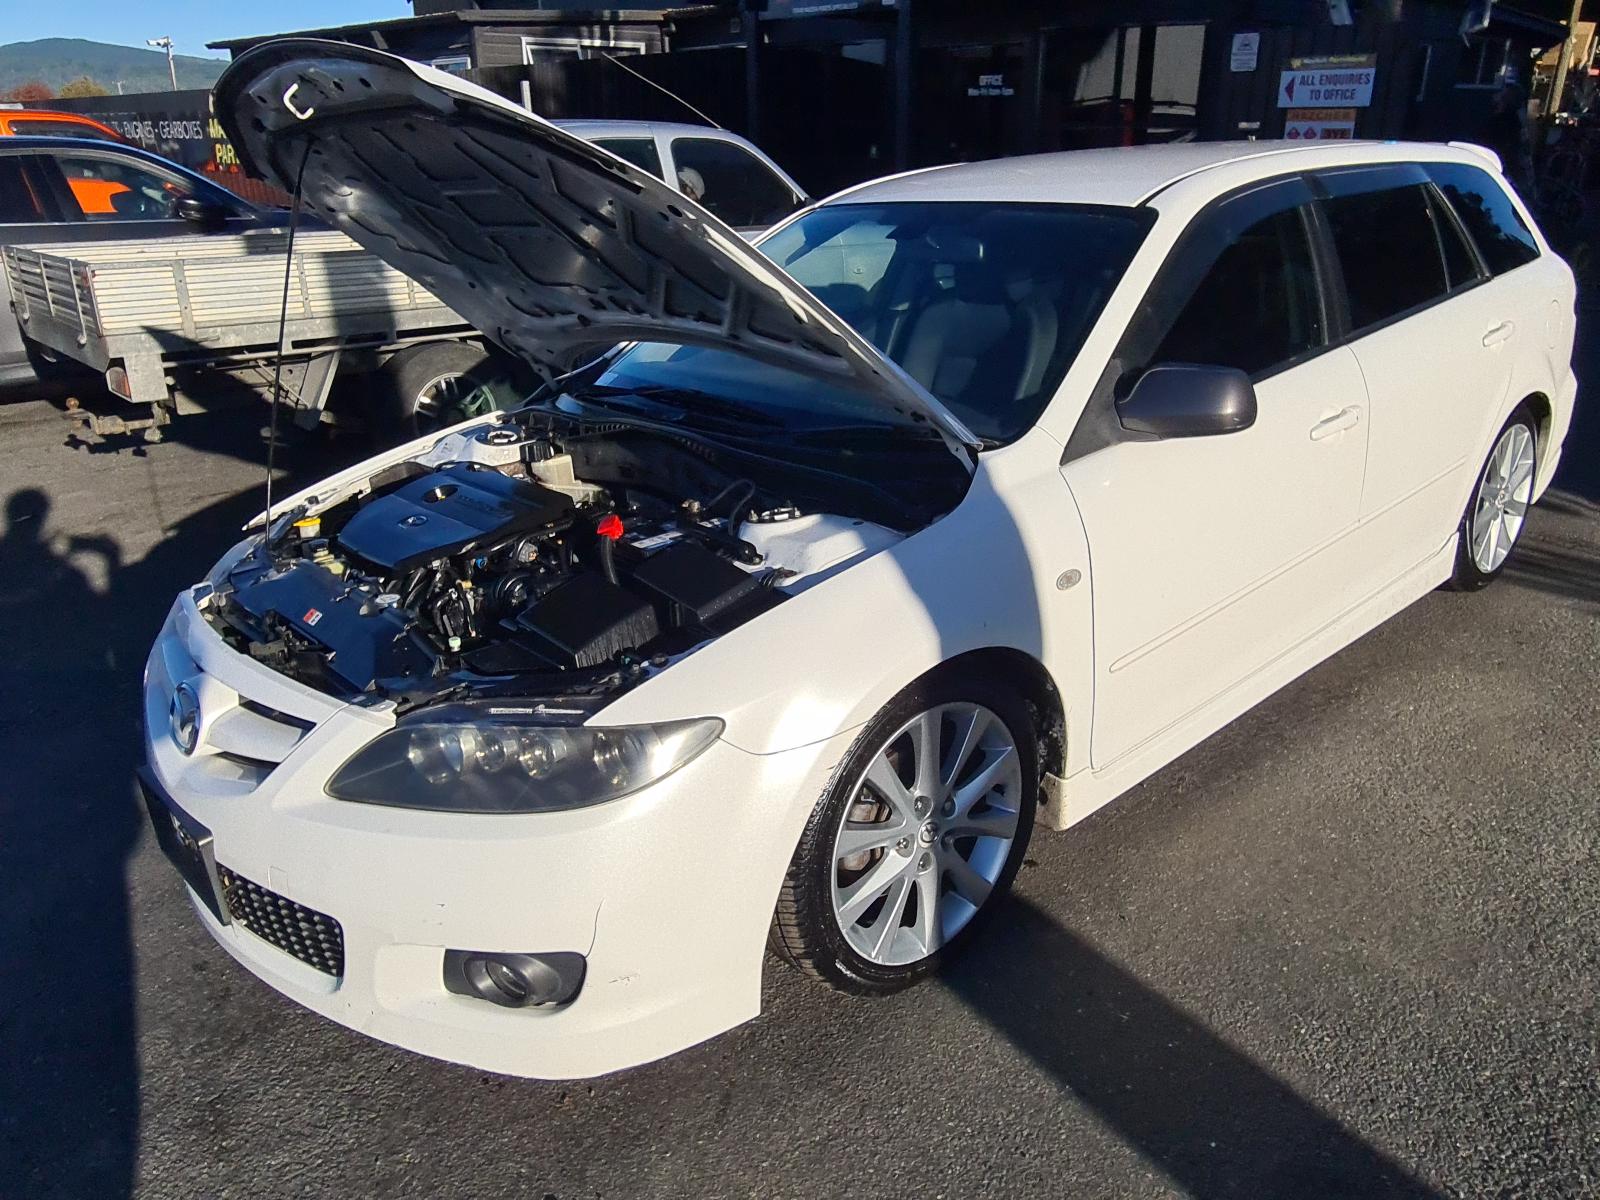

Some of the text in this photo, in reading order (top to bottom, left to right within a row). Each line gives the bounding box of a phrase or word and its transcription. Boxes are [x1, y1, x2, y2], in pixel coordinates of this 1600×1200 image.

[1298, 73, 1371, 87] ALL ENQUIRIES
[1309, 88, 1356, 101] TO OFFICE
[123, 121, 155, 139] ENGINES
[159, 120, 203, 140] GEARBOXES
[208, 118, 227, 139] MA
[215, 143, 240, 164] PAR
